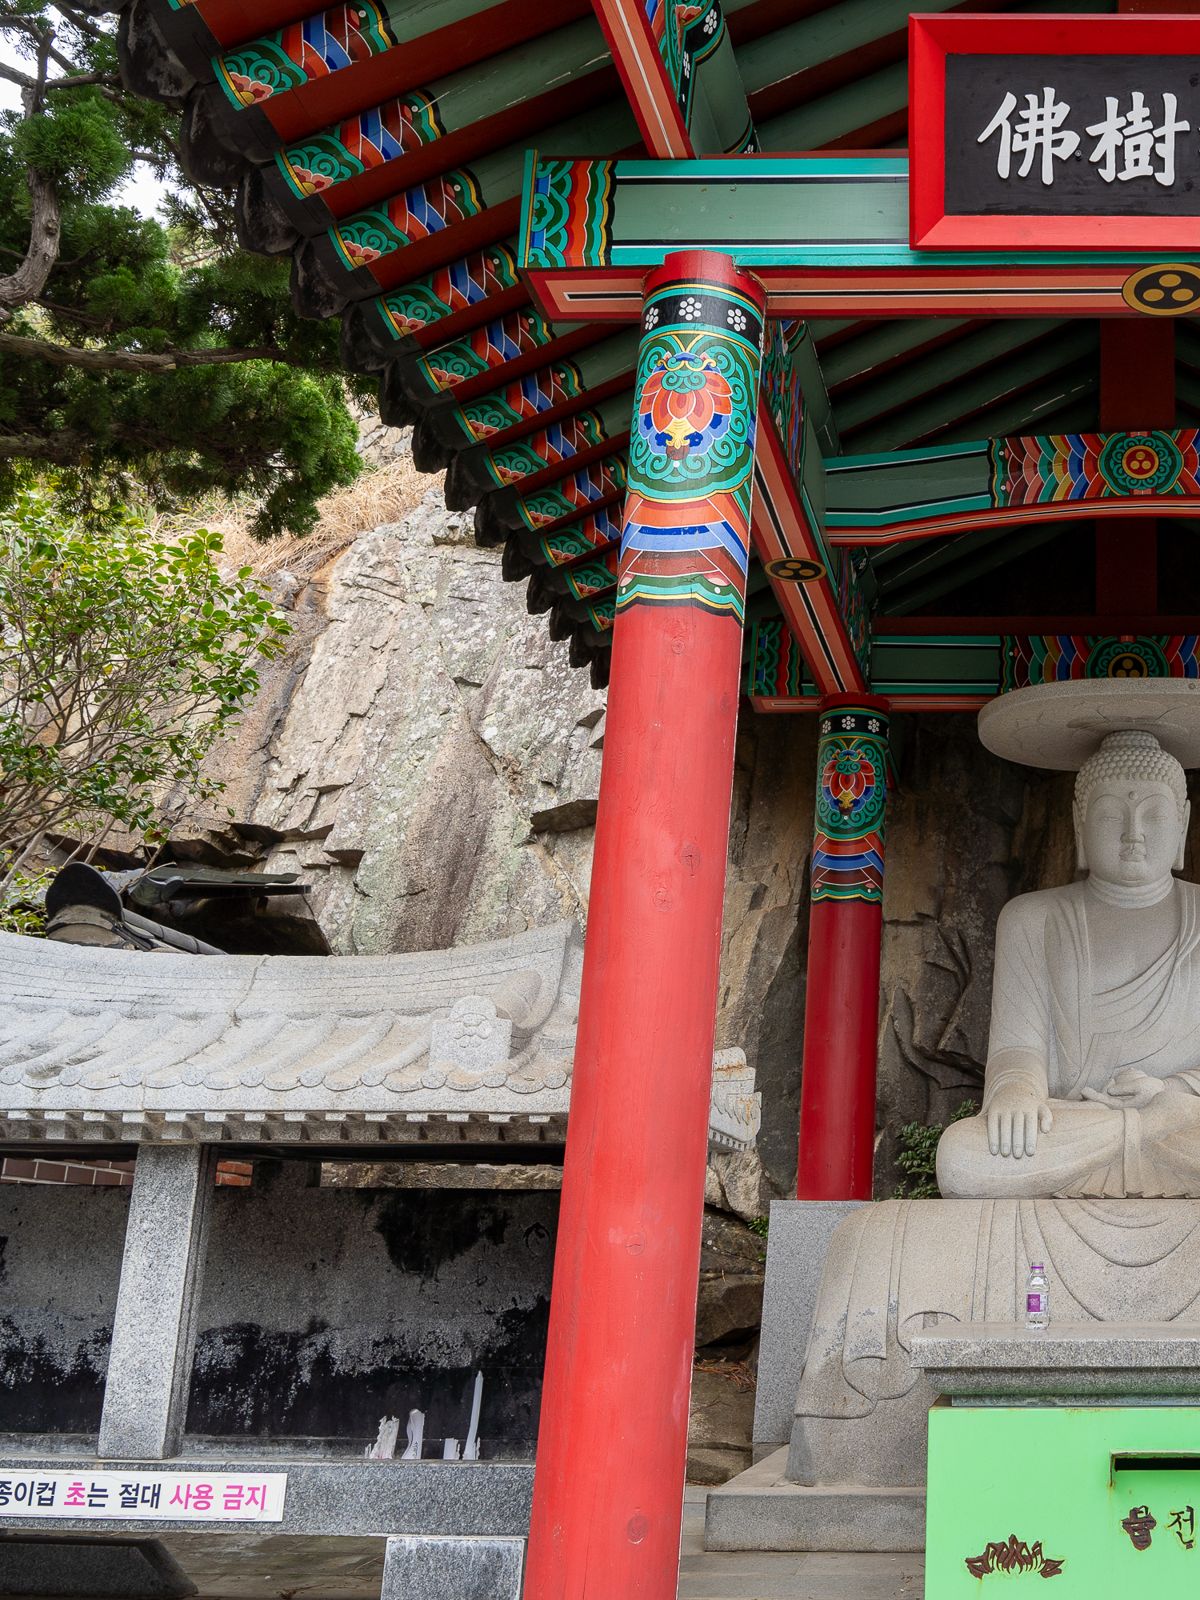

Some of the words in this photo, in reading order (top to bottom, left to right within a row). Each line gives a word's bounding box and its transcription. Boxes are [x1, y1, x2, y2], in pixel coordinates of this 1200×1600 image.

[0, 1480, 57, 1507] 종이컵
[63, 1481, 109, 1508] 초는
[118, 1482, 162, 1510] 절대
[169, 1483, 214, 1511] 사용
[222, 1484, 267, 1511] 금지
